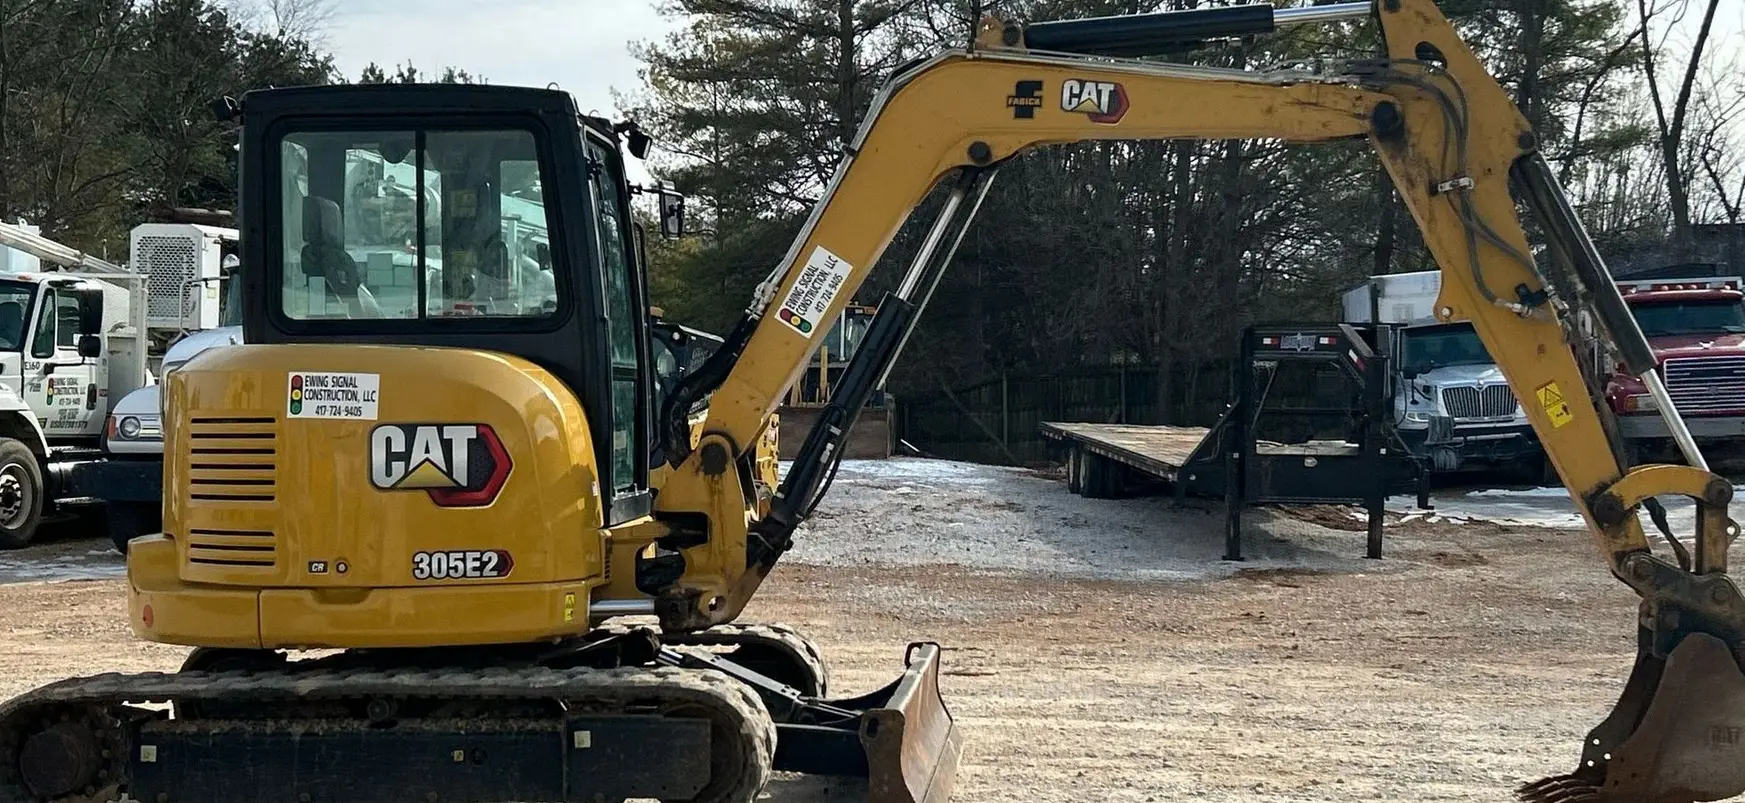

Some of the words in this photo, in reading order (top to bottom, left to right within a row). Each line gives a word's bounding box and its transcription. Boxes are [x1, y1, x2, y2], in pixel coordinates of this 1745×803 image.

[1063, 79, 1115, 114] CAT
[824, 256, 838, 269] LLC
[785, 286, 805, 310] EWING
[799, 264, 820, 289] SIGNAL
[305, 376, 328, 387] EWING
[332, 376, 358, 388] SIGNAL
[304, 388, 360, 403] CONSTRUCTION,
[363, 390, 376, 402] LLC
[315, 405, 362, 416] 417-724-9405
[371, 425, 477, 488] CAT
[311, 562, 325, 572] CR
[413, 551, 499, 579] 305E2
